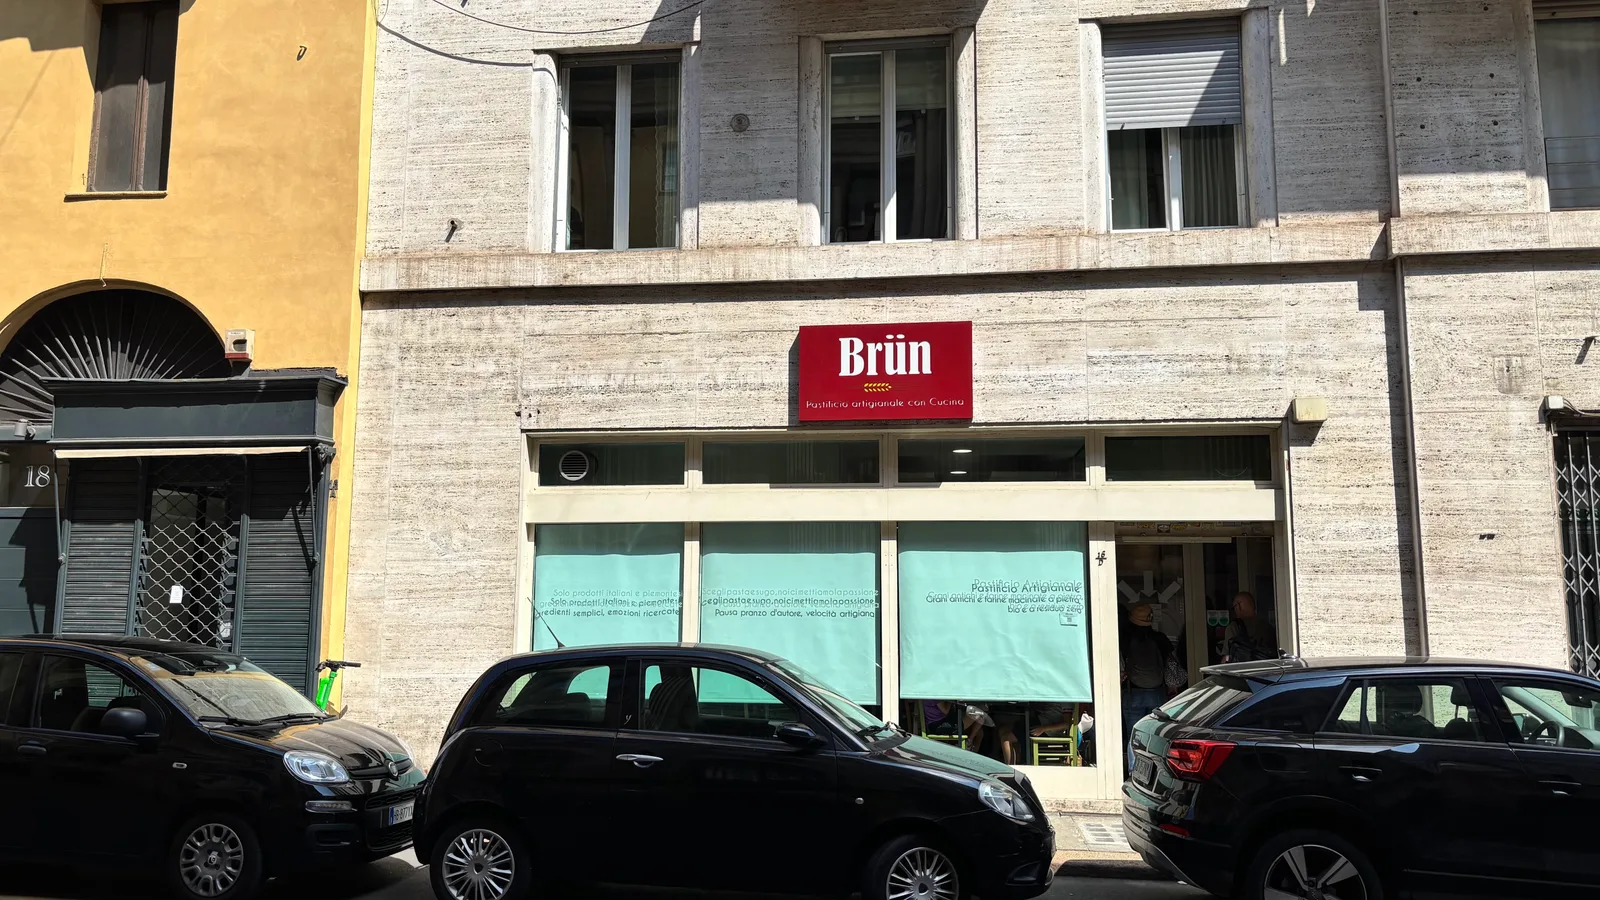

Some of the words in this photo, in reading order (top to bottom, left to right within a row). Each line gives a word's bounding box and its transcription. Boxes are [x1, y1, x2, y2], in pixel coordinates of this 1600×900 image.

[838, 334, 932, 377] Brün
[806, 400, 848, 409] Pastificio
[852, 398, 904, 410] artigianale
[929, 397, 964, 407] Cucina
[24, 464, 51, 488] 18
[715, 608, 738, 617] Pausa
[740, 610, 767, 618] pranzo
